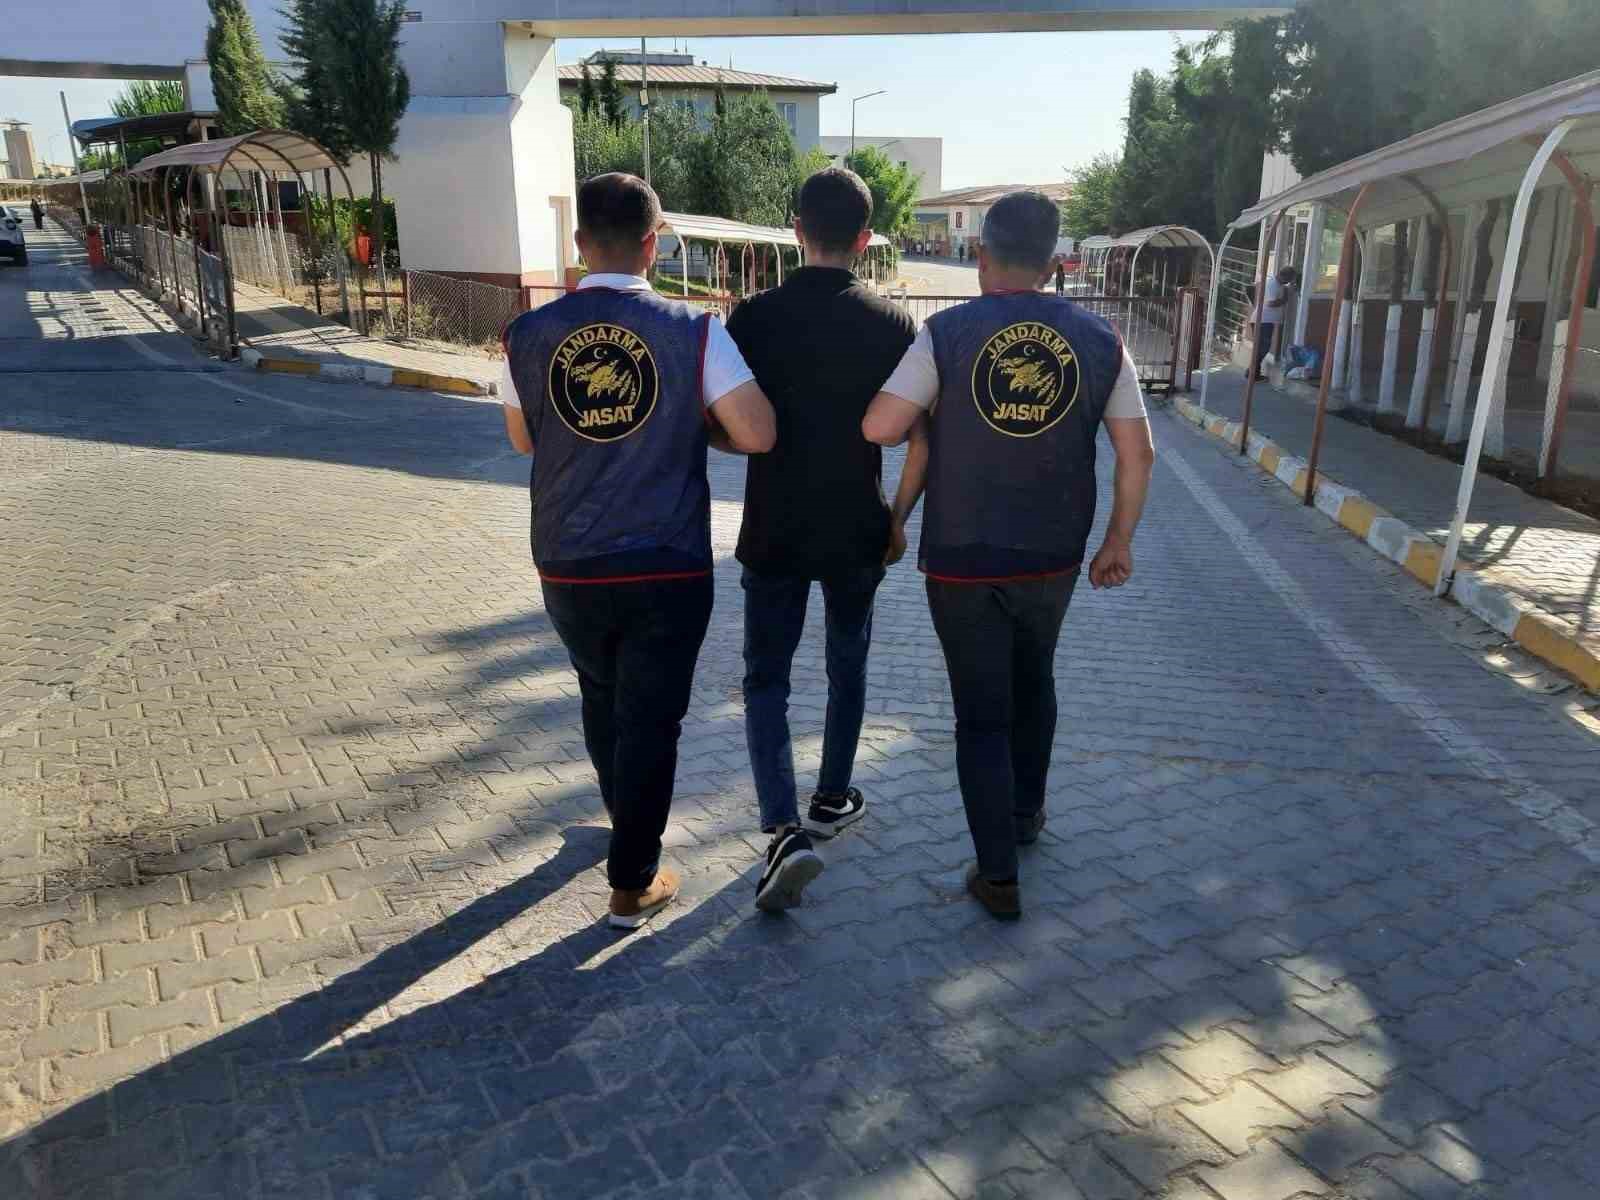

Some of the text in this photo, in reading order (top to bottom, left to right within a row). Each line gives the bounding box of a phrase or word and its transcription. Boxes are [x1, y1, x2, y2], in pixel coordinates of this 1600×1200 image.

[557, 327, 646, 369] JANDARMA
[987, 326, 1072, 366] JANDARMA
[578, 405, 635, 428] JASAT
[993, 403, 1050, 421] JASAT
